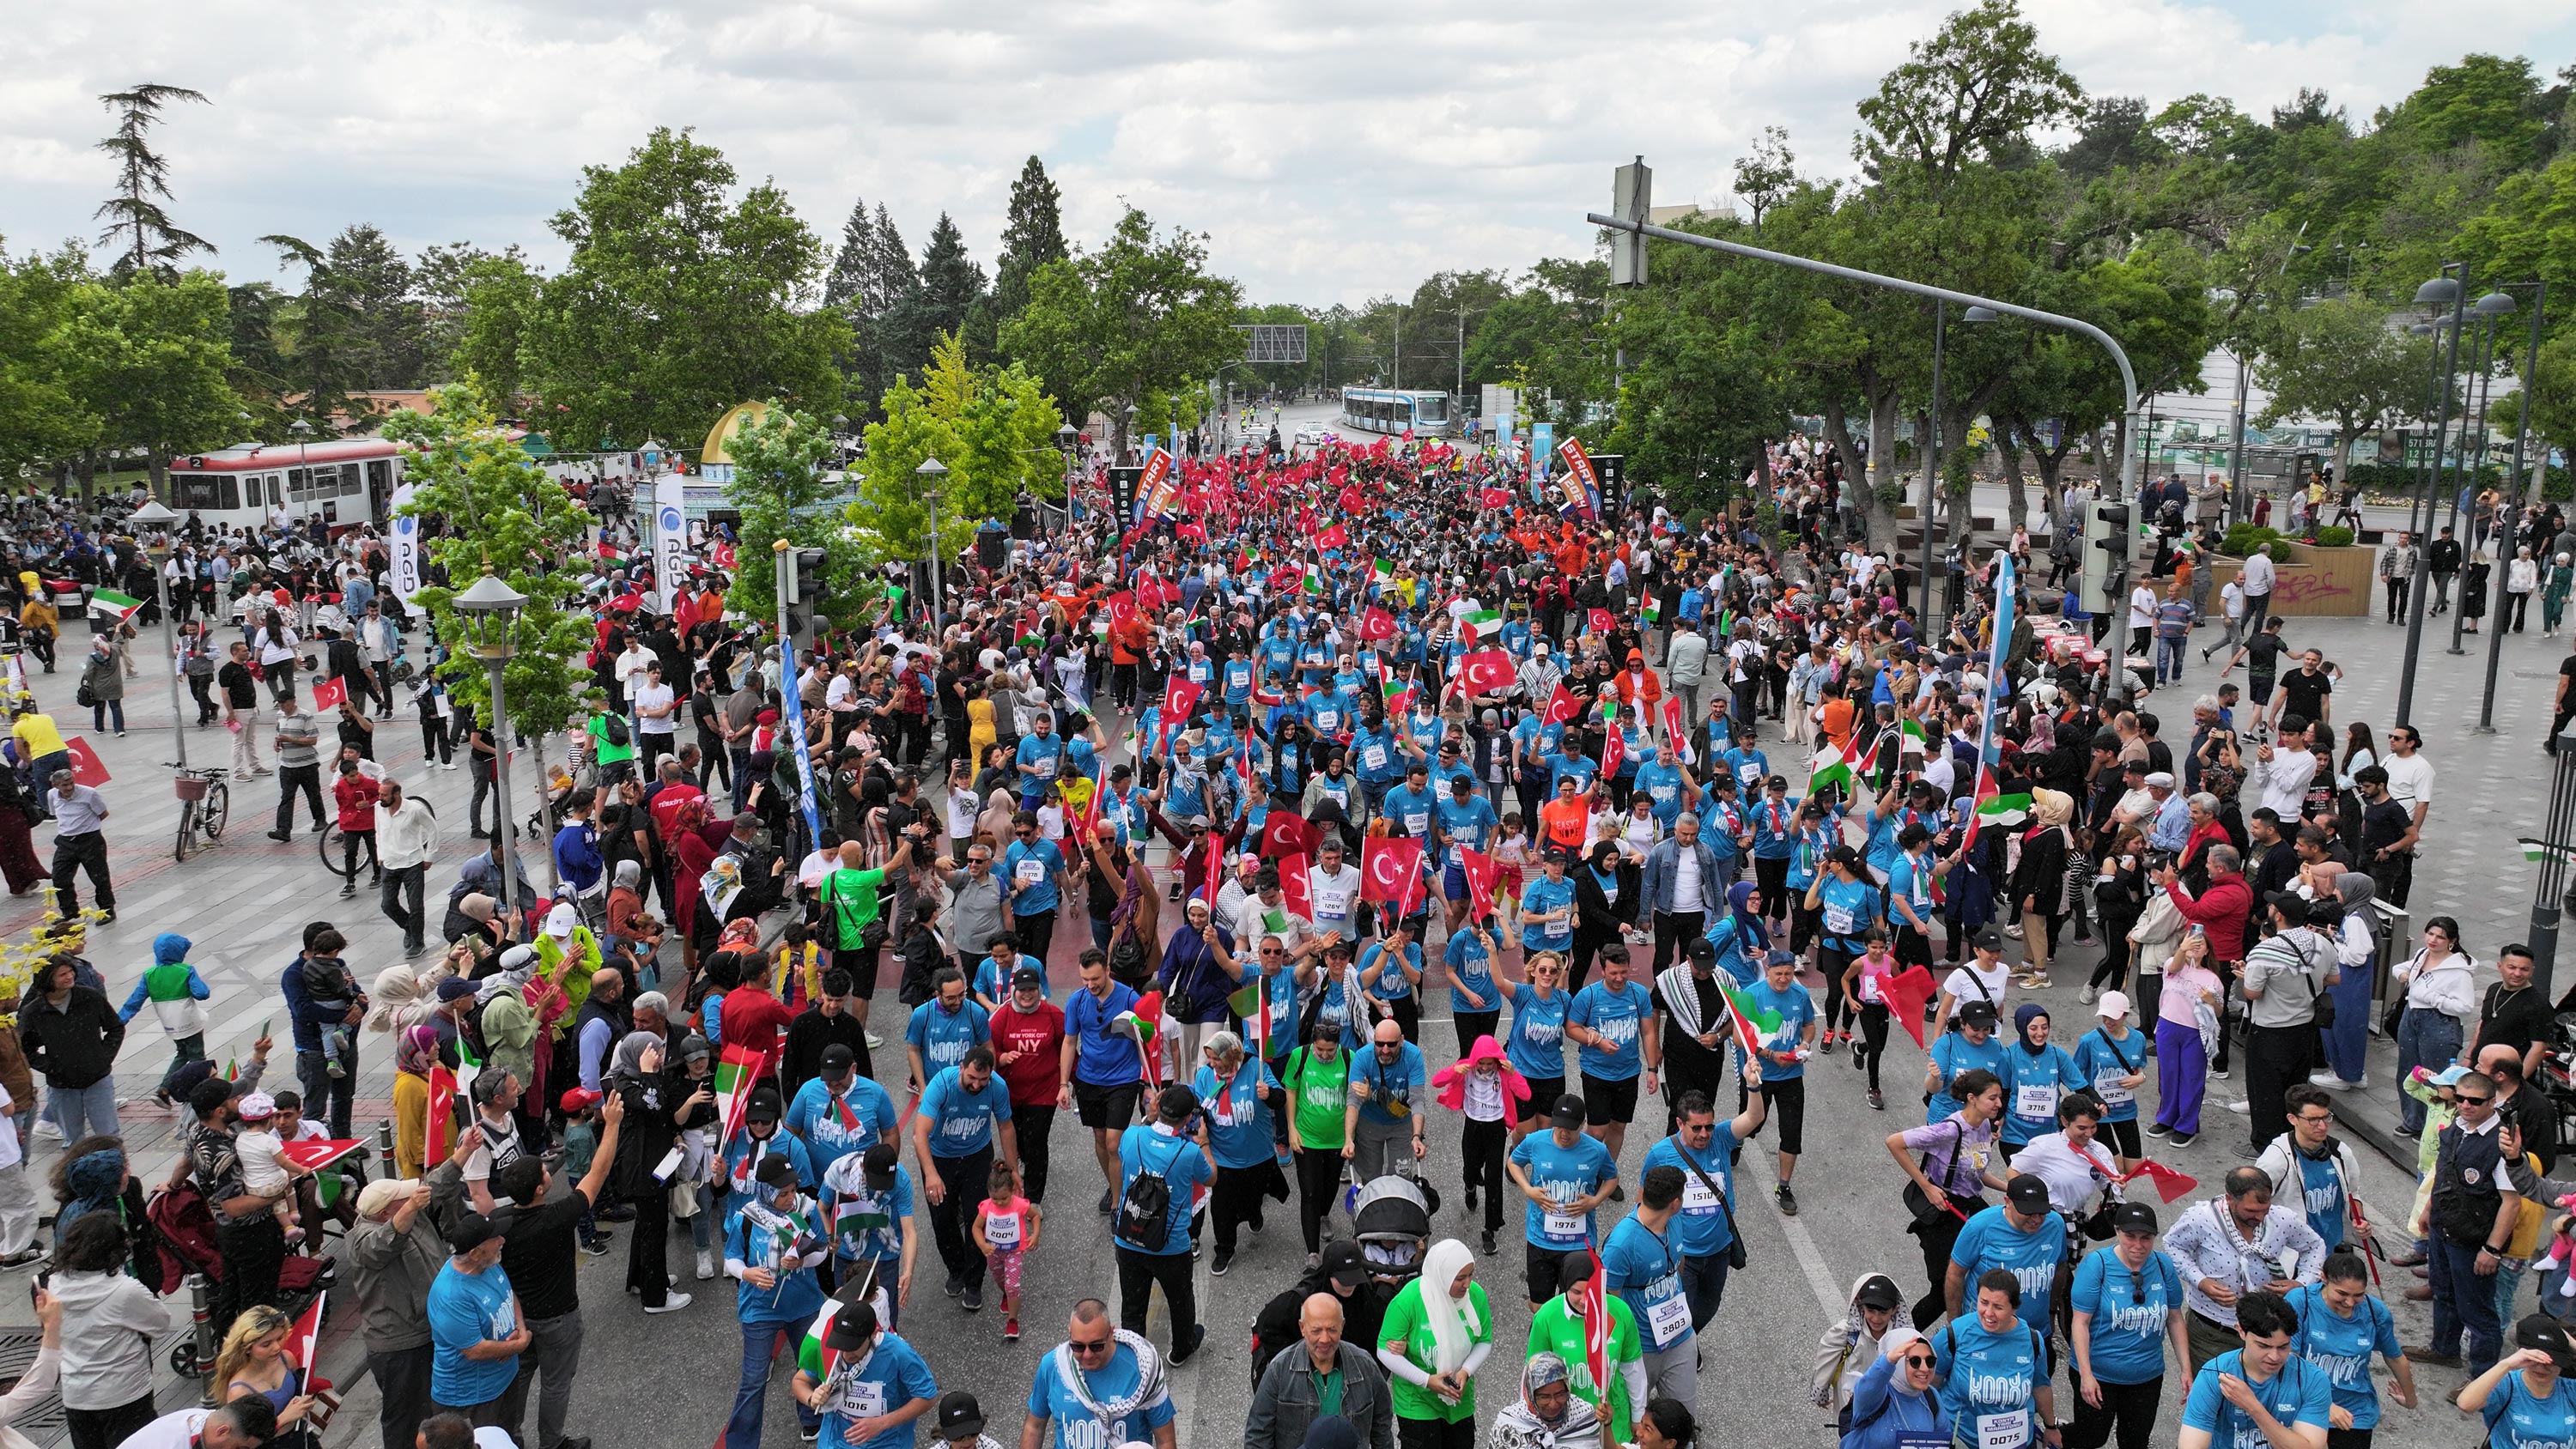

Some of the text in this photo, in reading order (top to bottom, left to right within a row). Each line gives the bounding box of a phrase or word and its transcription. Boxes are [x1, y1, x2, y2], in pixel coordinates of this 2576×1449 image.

[2309, 438, 2325, 446] KART
[2409, 439, 2421, 447] 571
[193, 458, 201, 468] 2
[1564, 444, 1595, 487] START
[1139, 454, 1166, 500] START
[1564, 478, 1587, 508] 2024
[1147, 488, 1169, 518] 2024
[402, 543, 416, 594] AGD
[667, 538, 684, 590] AGD
[658, 798, 684, 809] TÜRKİYE
[1557, 819, 1579, 830] EASY?
[1018, 1040, 1041, 1052] NY
[2103, 1091, 2126, 1100] 3924
[1692, 1191, 1713, 1201] 1510
[991, 1230, 1014, 1239] 2004
[1662, 1318, 1686, 1336] 2803
[844, 1401, 868, 1411] 1016
[1990, 1433, 2021, 1446] 0075
